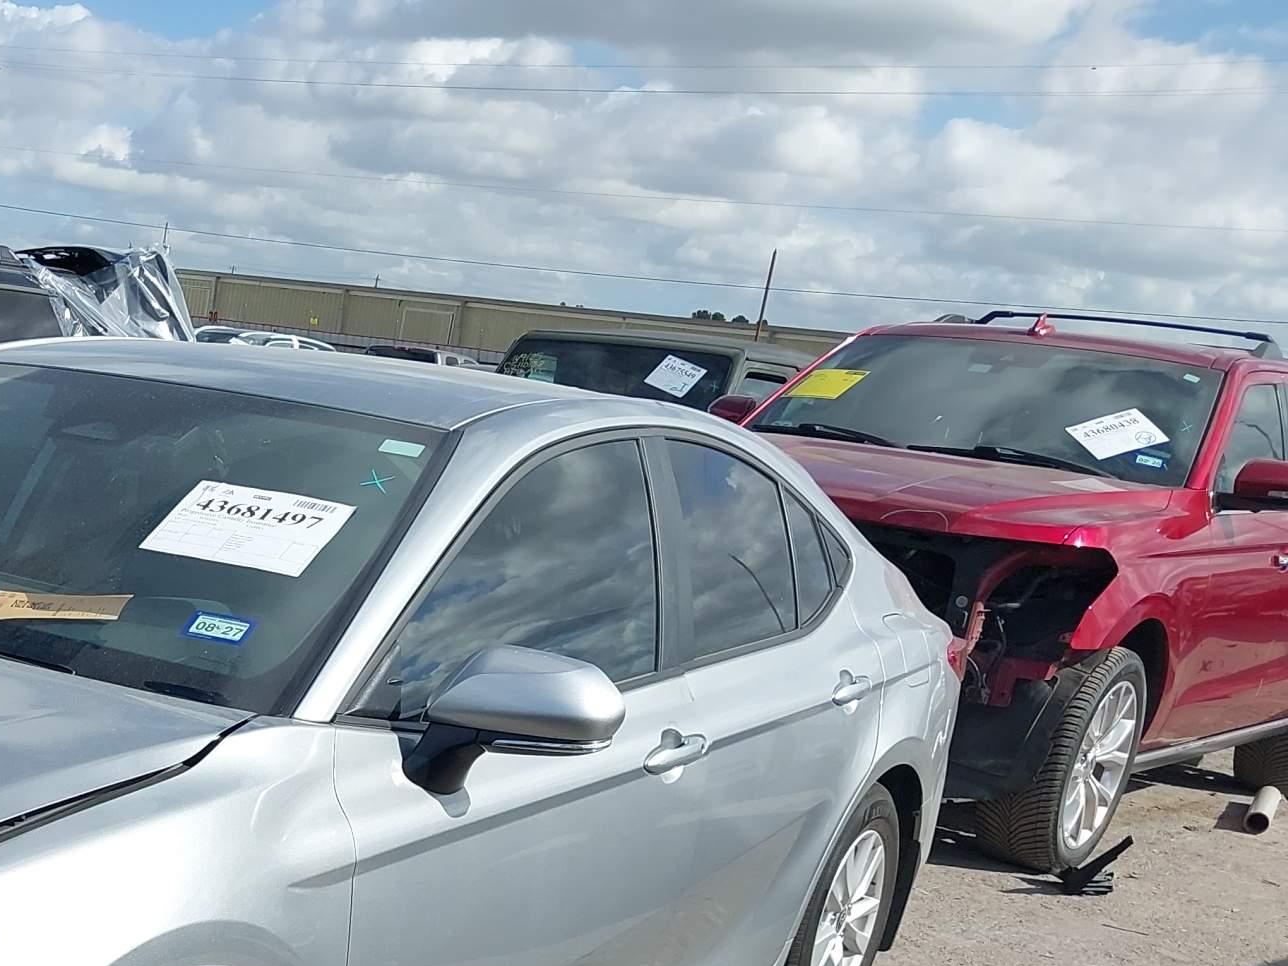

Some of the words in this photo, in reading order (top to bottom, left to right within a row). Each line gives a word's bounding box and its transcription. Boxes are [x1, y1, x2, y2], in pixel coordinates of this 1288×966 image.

[1083, 417, 1140, 438] 43680438
[196, 496, 325, 529] 43681497
[195, 621, 217, 633] 08
[220, 626, 244, 637] 27
